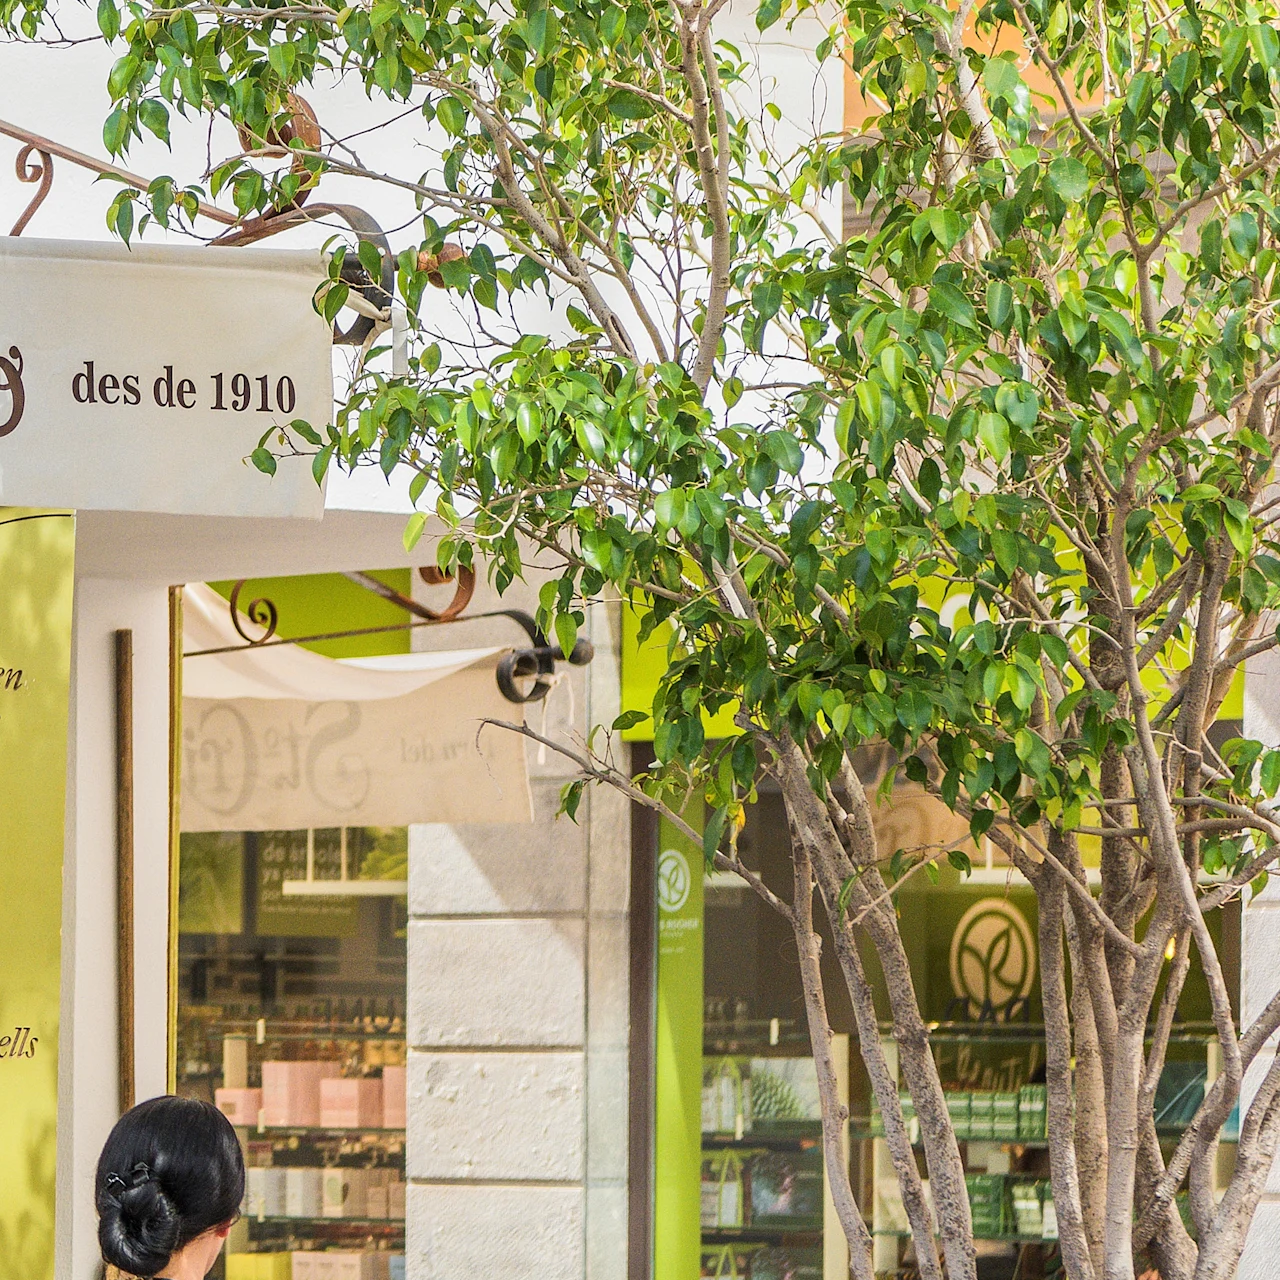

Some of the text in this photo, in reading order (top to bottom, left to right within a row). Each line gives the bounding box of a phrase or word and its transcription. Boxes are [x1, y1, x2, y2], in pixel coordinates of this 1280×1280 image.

[71, 360, 296, 413] des de 1910
